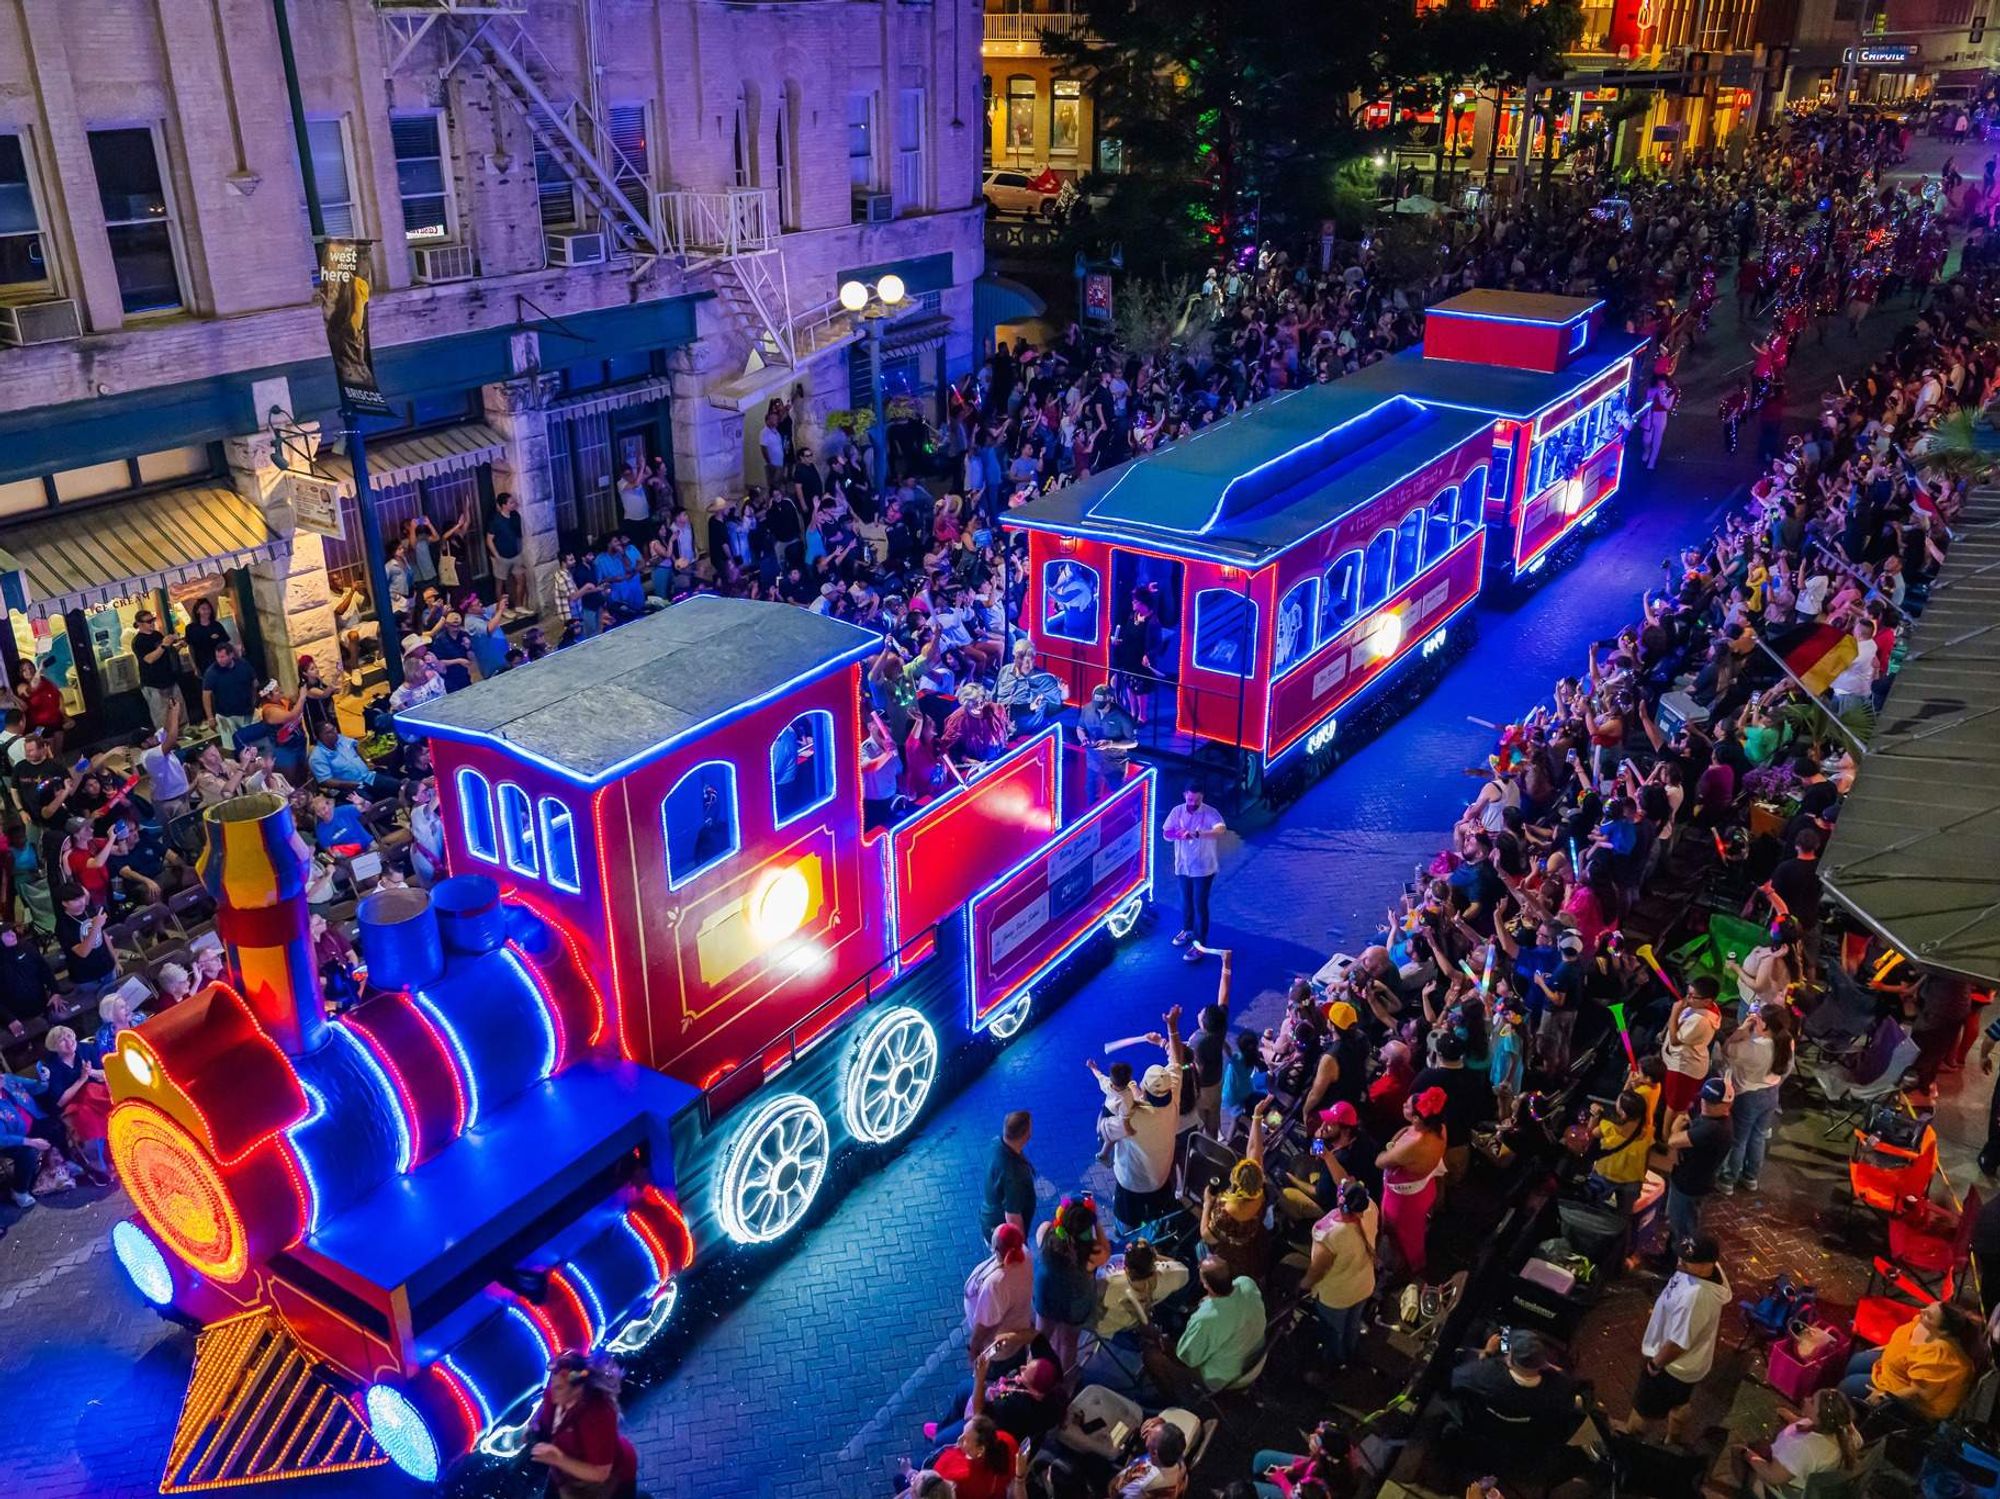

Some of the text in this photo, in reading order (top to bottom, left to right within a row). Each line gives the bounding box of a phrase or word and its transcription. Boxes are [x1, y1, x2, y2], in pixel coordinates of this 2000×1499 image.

[330, 251, 357, 263] west
[321, 266, 350, 283] here
[344, 387, 385, 403] BRISCOE
